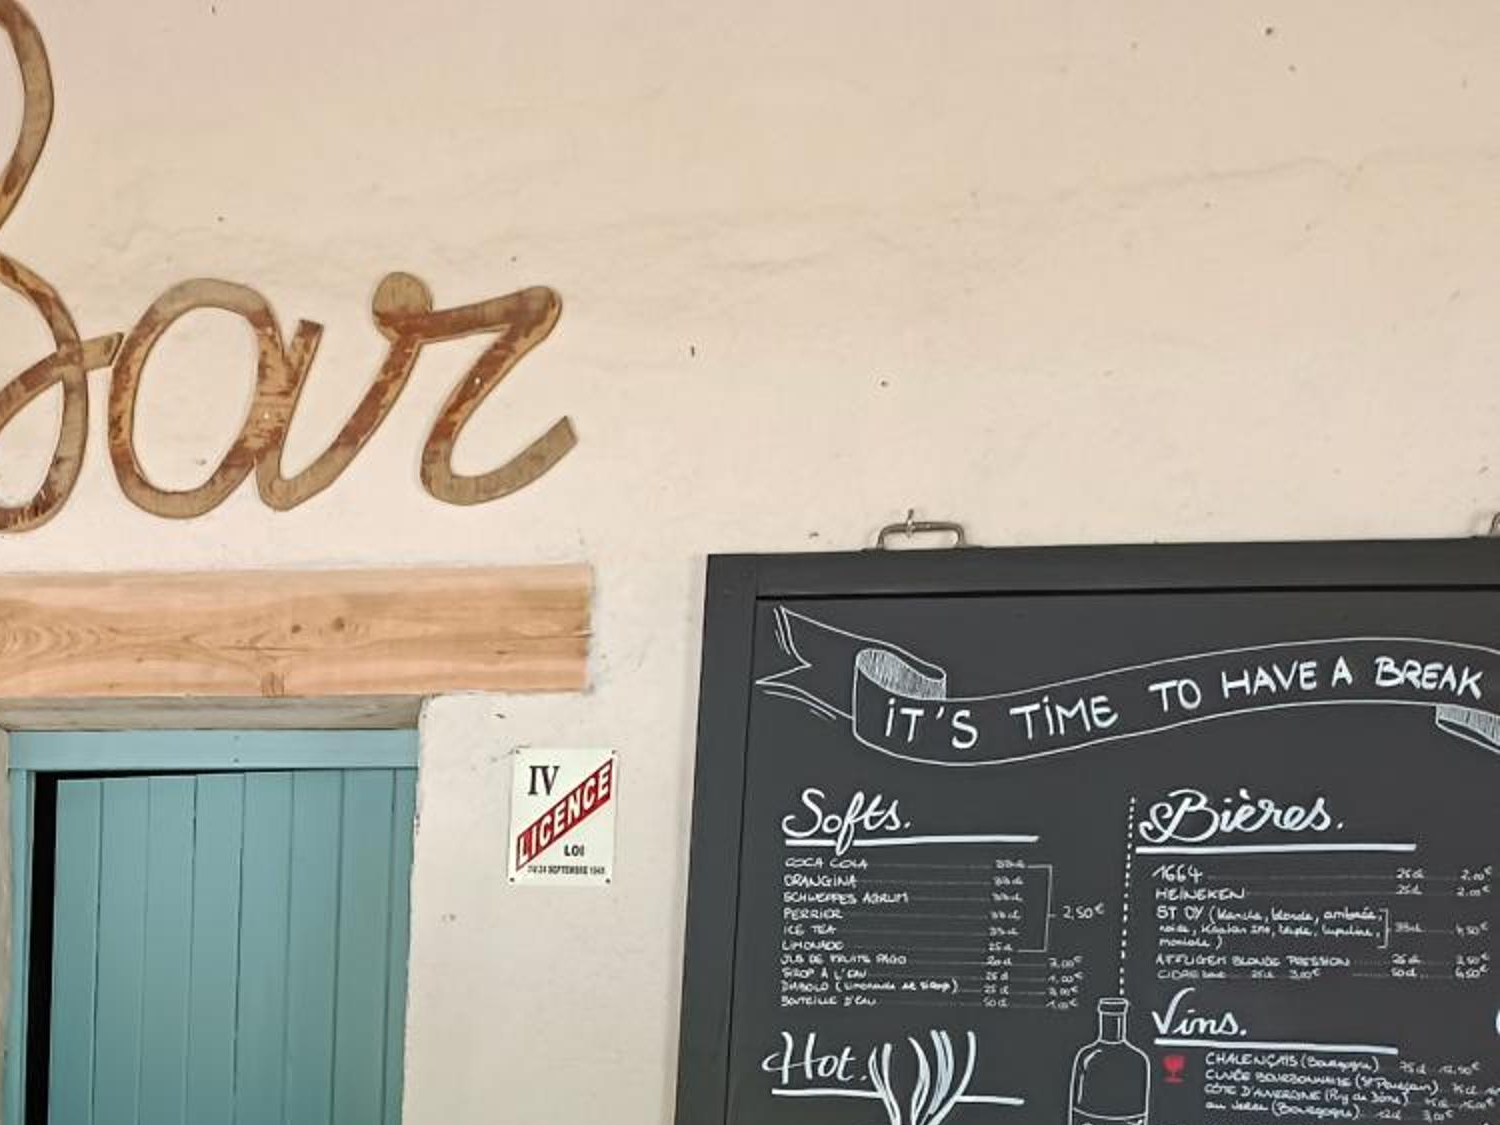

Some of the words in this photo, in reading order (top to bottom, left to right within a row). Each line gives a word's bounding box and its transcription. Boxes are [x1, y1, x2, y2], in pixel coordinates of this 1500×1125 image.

[1148, 678, 1201, 712] TO
[1220, 660, 1318, 699] HAVE
[1331, 655, 1353, 688] A
[1374, 656, 1484, 700] BREAK
[528, 765, 560, 796] IV
[517, 762, 611, 866] LICENCE
[564, 844, 585, 857] LOI
[785, 857, 824, 868] COCA
[830, 858, 868, 869] COLA
[783, 873, 857, 888] ORANGINA
[1152, 863, 1203, 884] 1664
[1156, 905, 1178, 919] ST
[810, 923, 837, 936] TEA
